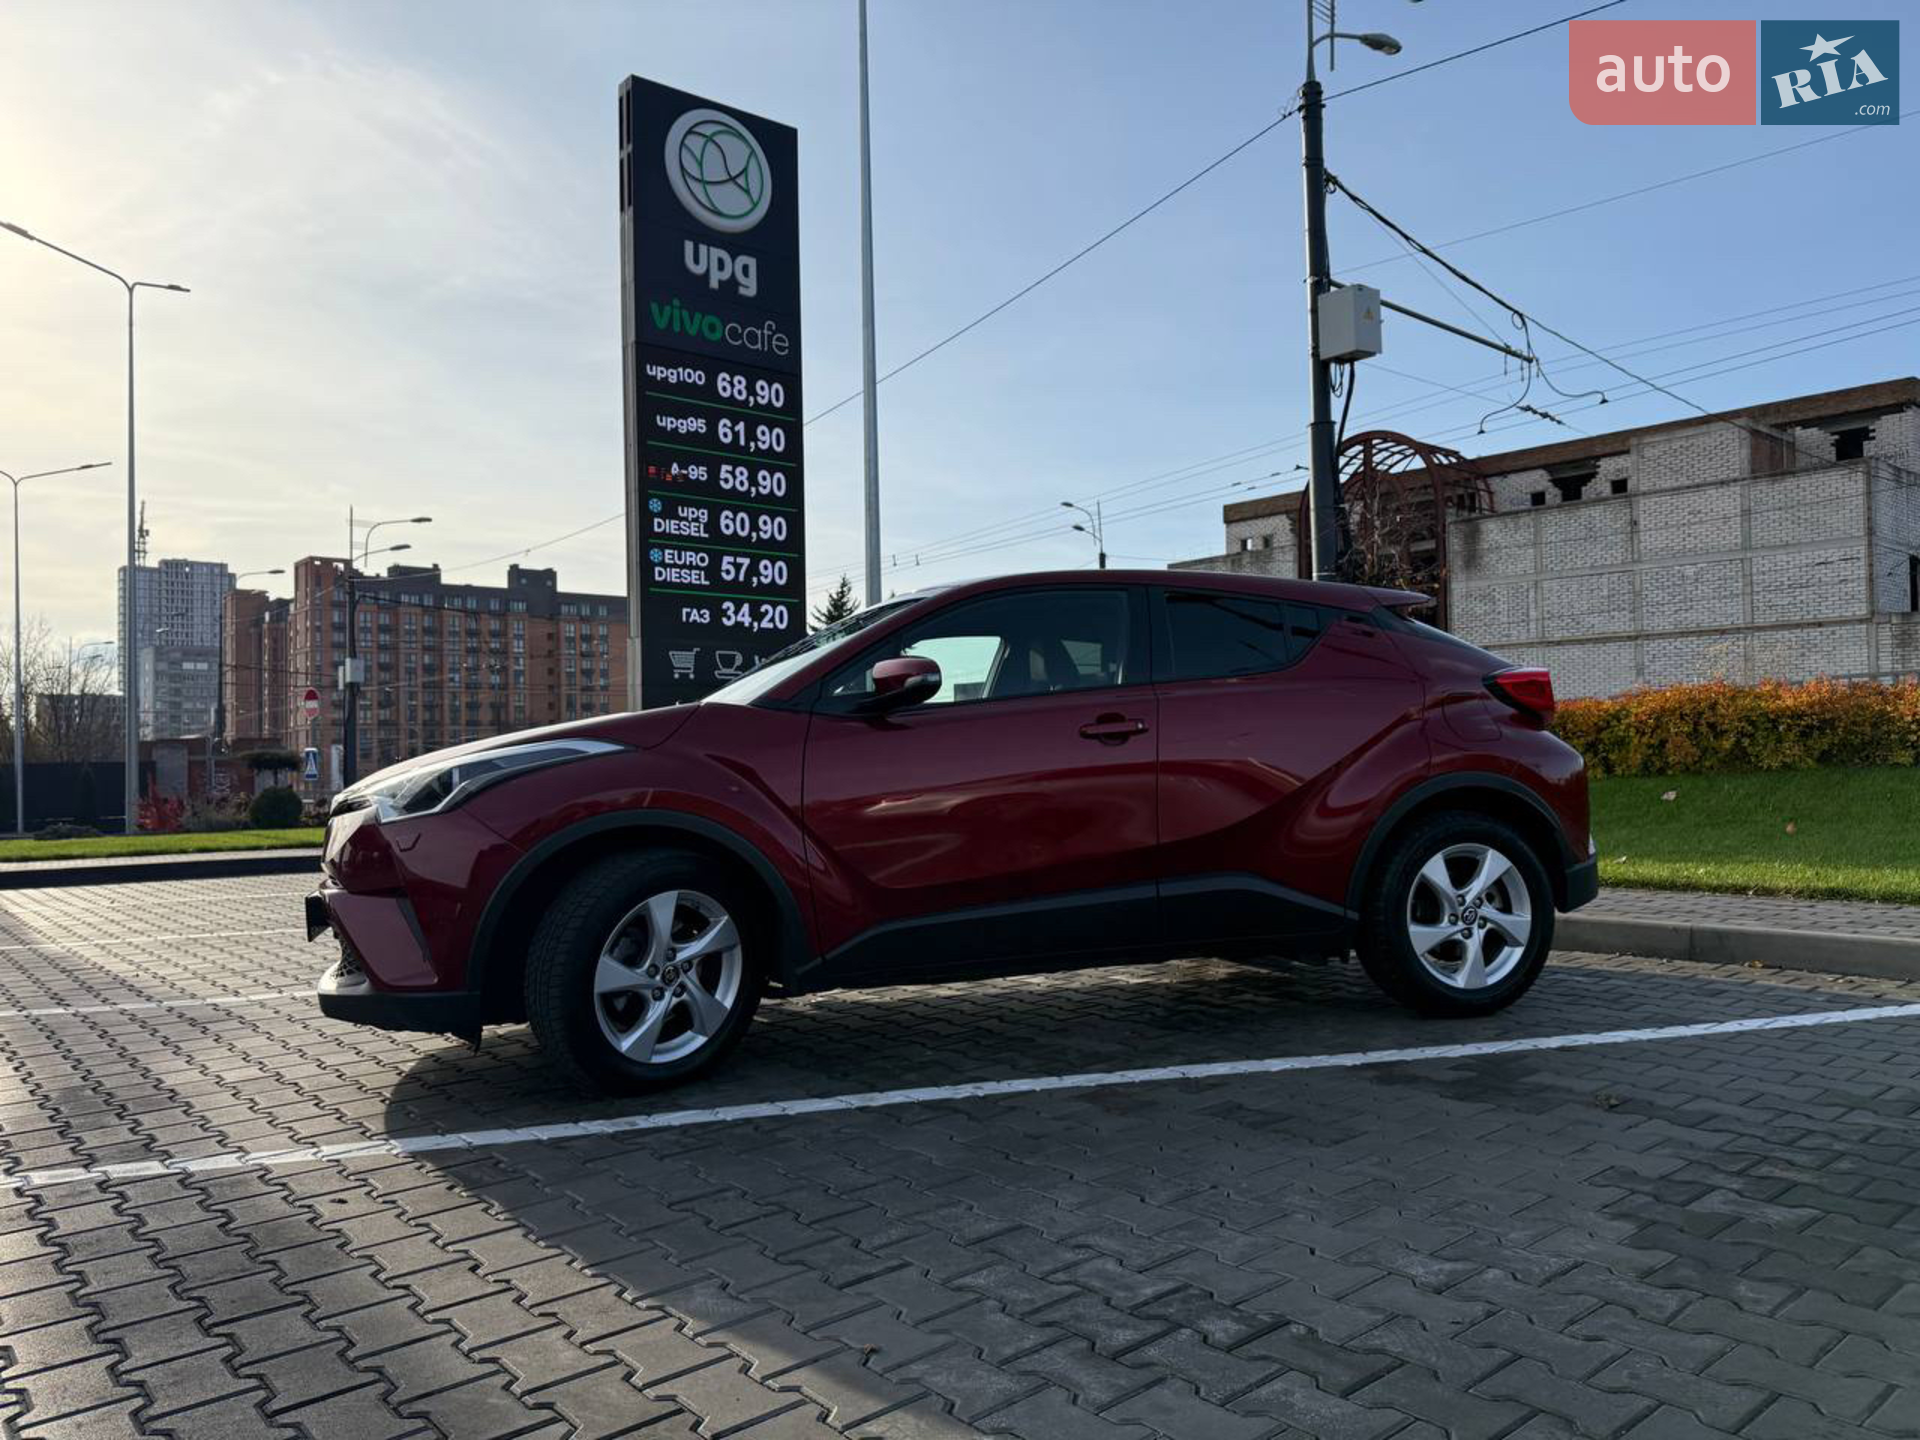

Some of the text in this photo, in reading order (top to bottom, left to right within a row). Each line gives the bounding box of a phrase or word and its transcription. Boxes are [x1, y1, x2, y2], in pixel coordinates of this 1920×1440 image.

[683, 239, 757, 298] upg
[645, 363, 785, 408] upg100 68,90
[656, 414, 786, 453] upg95 61,90
[719, 464, 787, 498] 58,90
[653, 518, 709, 538] DIESEL
[677, 505, 709, 523] upg
[719, 509, 787, 542] 60,90
[664, 548, 709, 567] EURO
[720, 555, 788, 587] 57,90
[653, 566, 710, 586] DIESEL
[681, 601, 789, 632] ГАЗ 34,20
